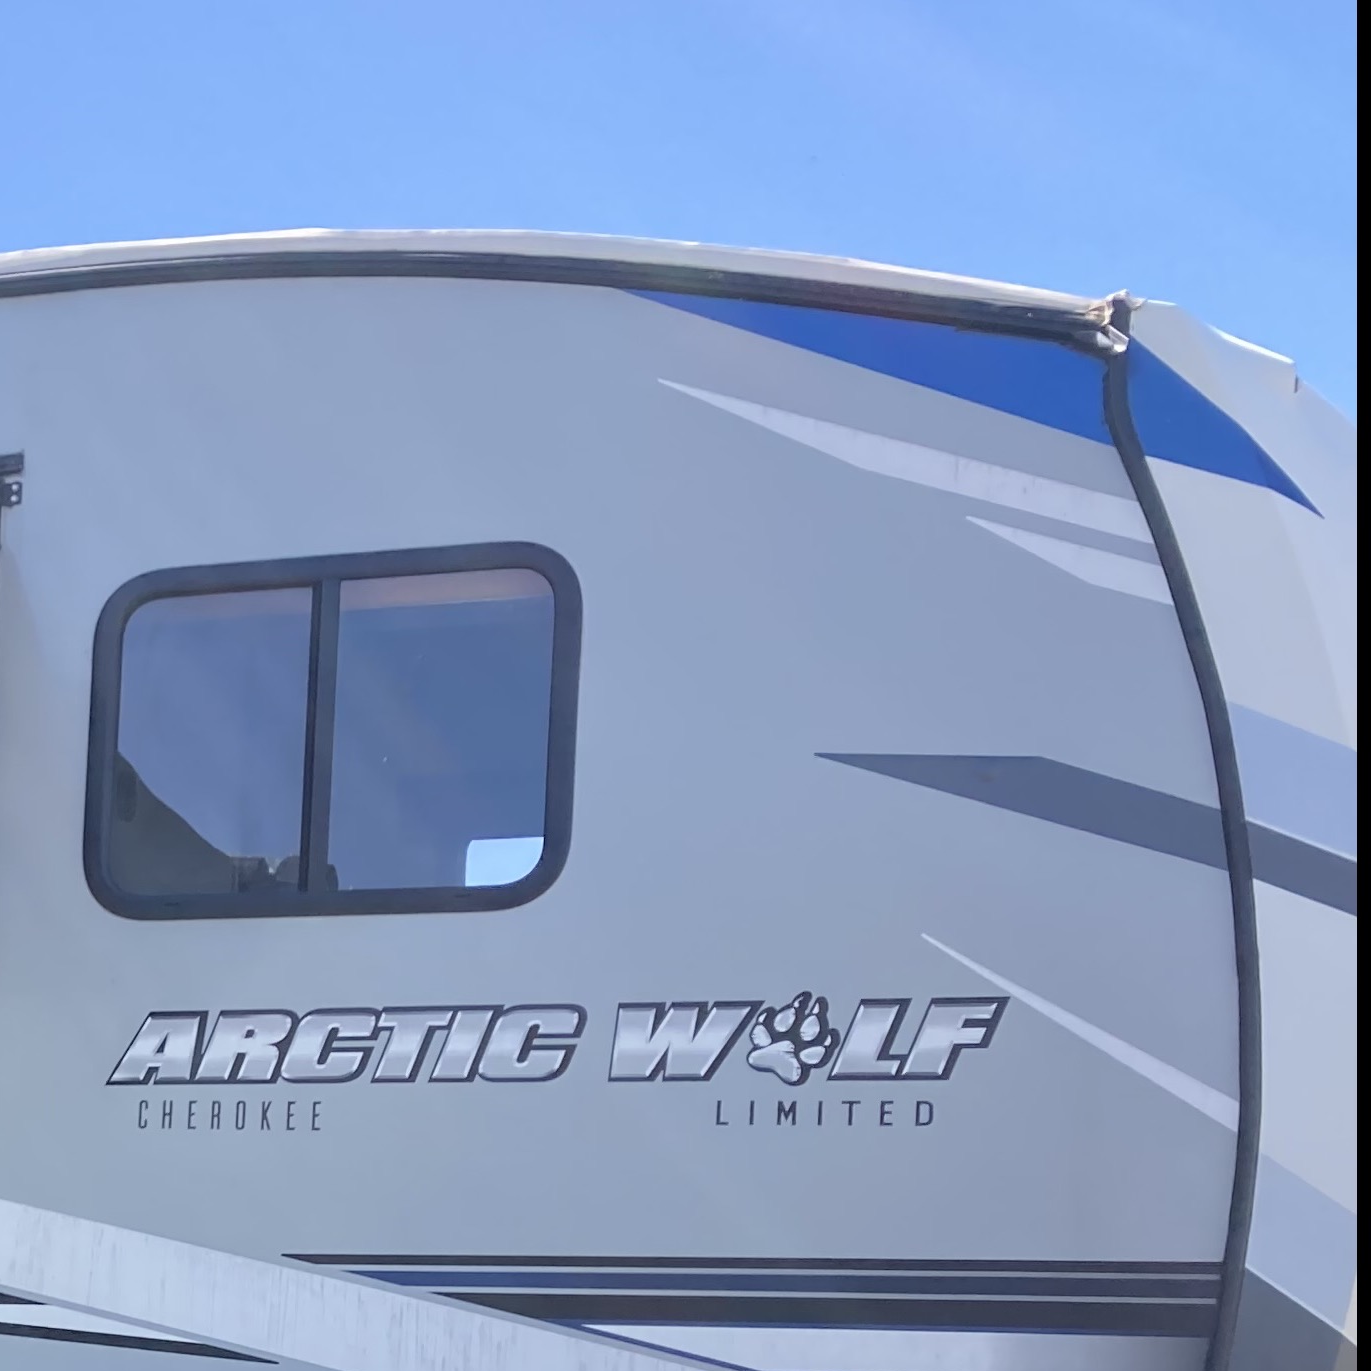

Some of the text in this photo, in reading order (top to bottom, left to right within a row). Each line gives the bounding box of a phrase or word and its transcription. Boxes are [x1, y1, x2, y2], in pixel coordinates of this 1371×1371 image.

[106, 1003, 588, 1085] ARCTIC
[138, 1100, 322, 1131] CHEROKEE
[715, 1100, 935, 1127] LIMITED
